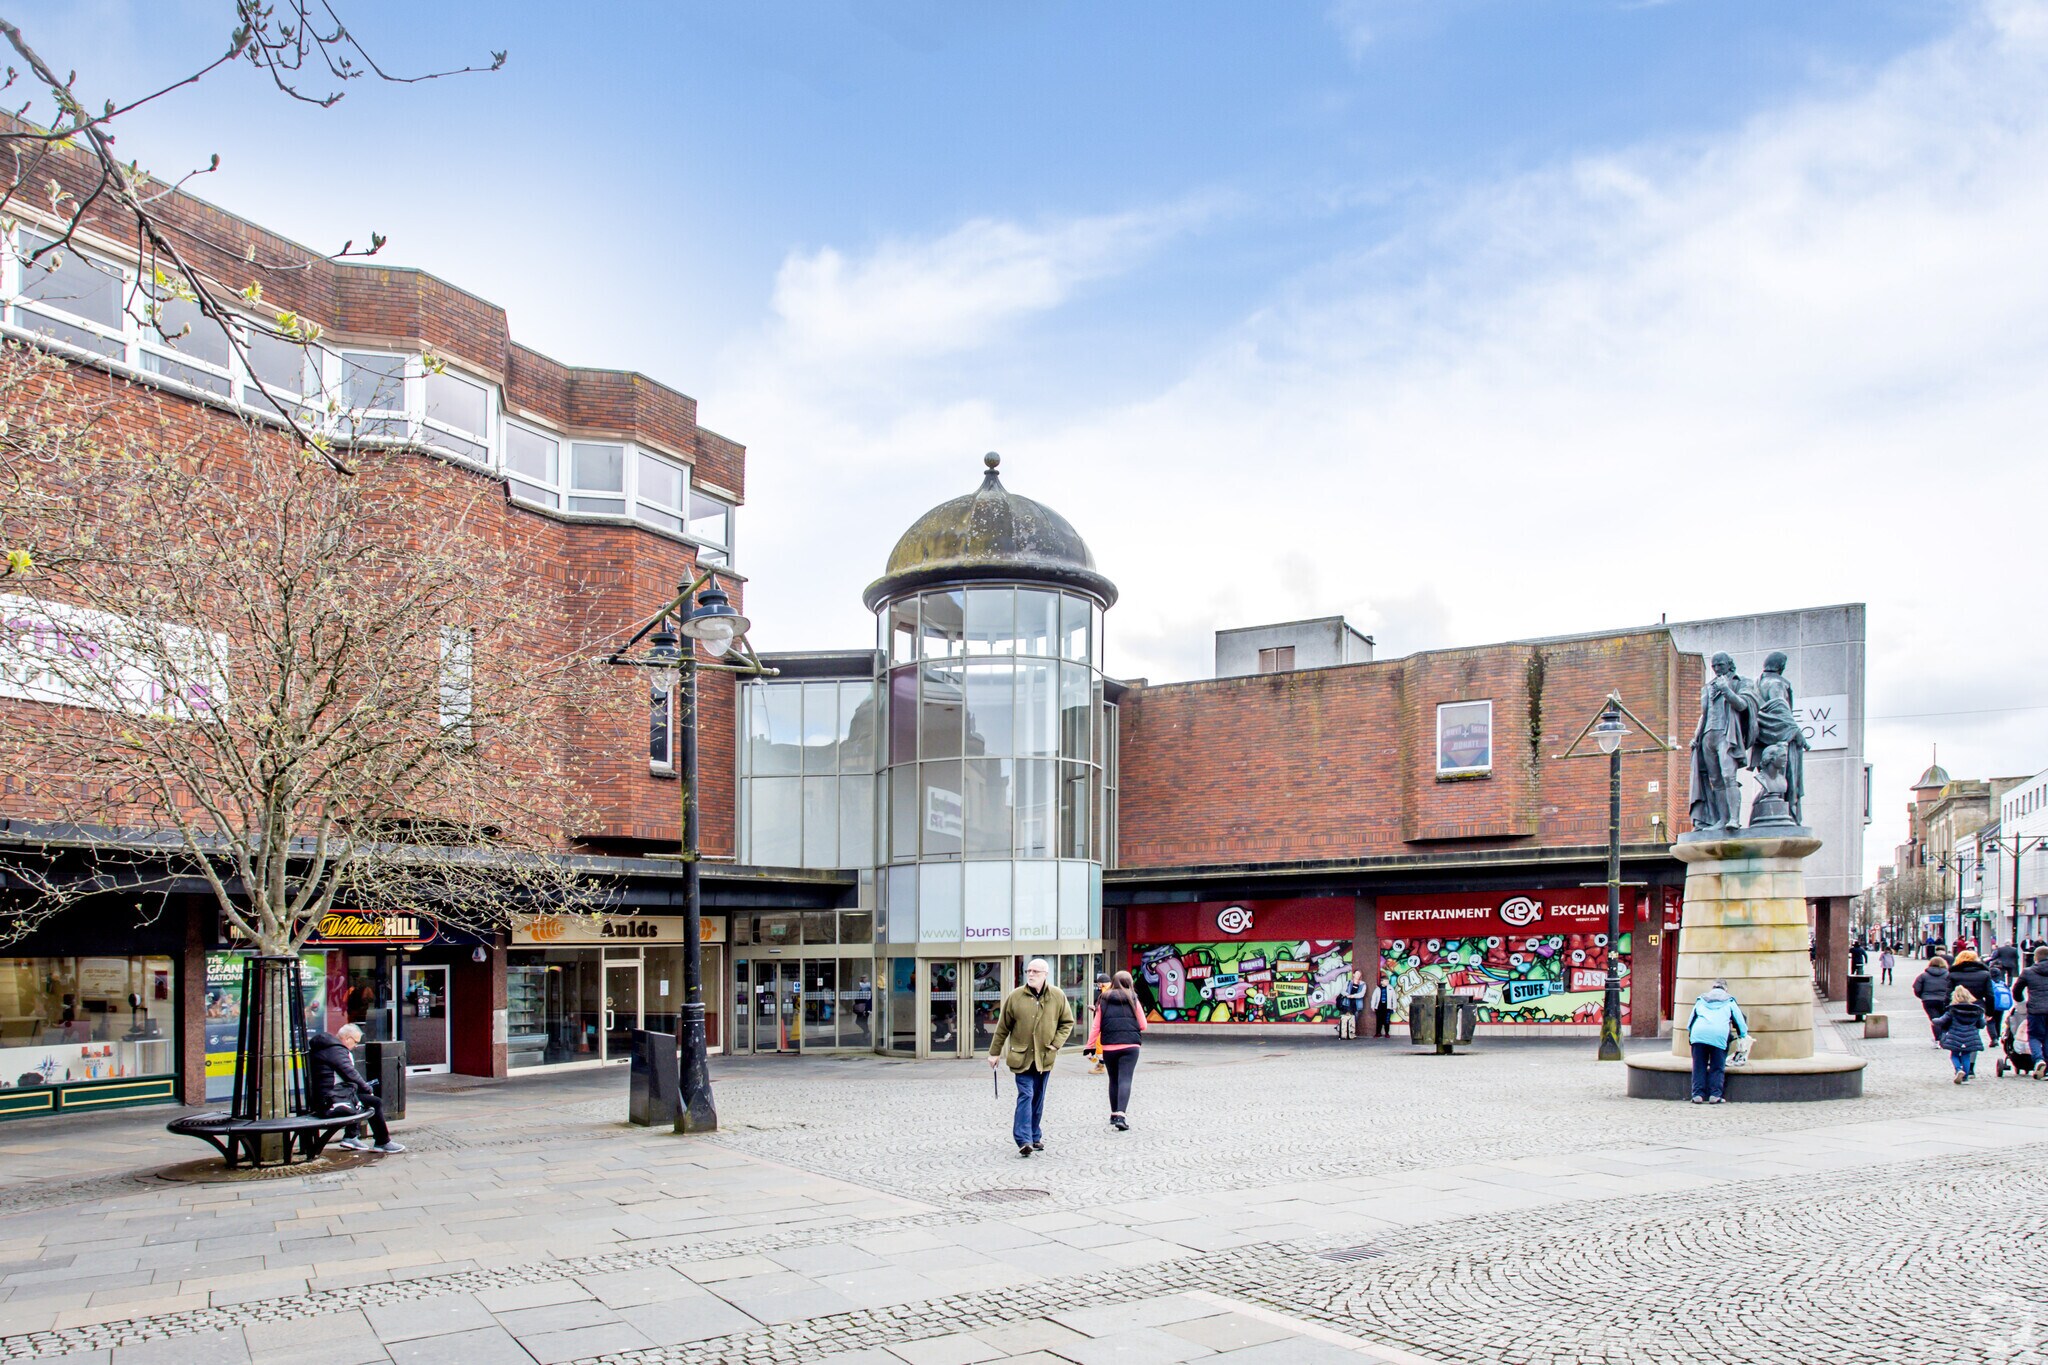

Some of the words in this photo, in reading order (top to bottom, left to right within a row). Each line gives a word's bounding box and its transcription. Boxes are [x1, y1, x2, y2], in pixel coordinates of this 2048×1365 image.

[1792, 707, 1831, 722] EW
[1801, 724, 1837, 739] OK
[1384, 907, 1492, 921] ENTERTAINMENT
[317, 914, 384, 936] William
[384, 917, 420, 936] HILL
[600, 920, 658, 938] Aulds
[921, 929, 960, 938] www.
[965, 926, 1011, 938] burns
[206, 956, 224, 965] THE
[206, 974, 244, 982] NATIONA
[1400, 969, 1421, 992] 24
[1447, 970, 1471, 987] WE
[1513, 983, 1545, 998] STUFF
[1280, 997, 1306, 1011] CASH
